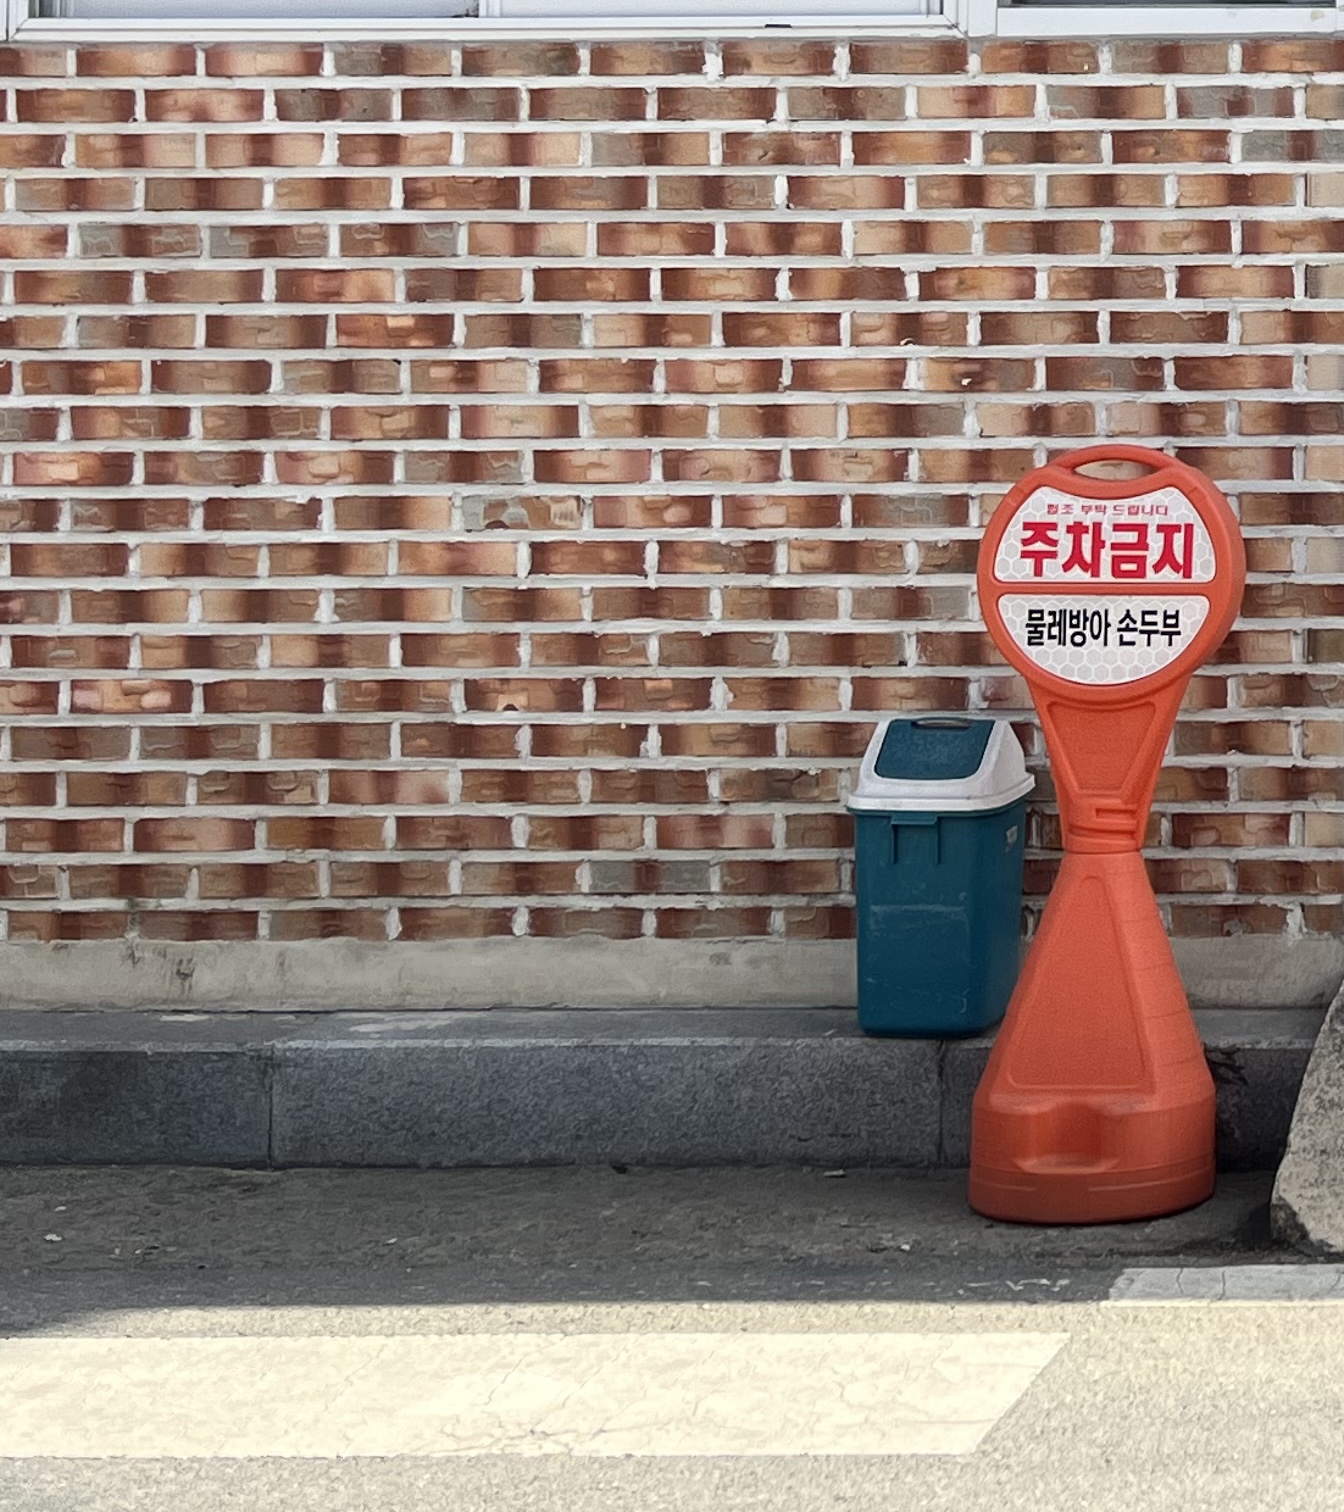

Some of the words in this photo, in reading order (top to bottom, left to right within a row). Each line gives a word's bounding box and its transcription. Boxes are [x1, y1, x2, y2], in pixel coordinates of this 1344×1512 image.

[1020, 521, 1195, 579] 주차금지
[1025, 608, 1111, 648] 물레방아
[1116, 608, 1182, 647] 손두부
